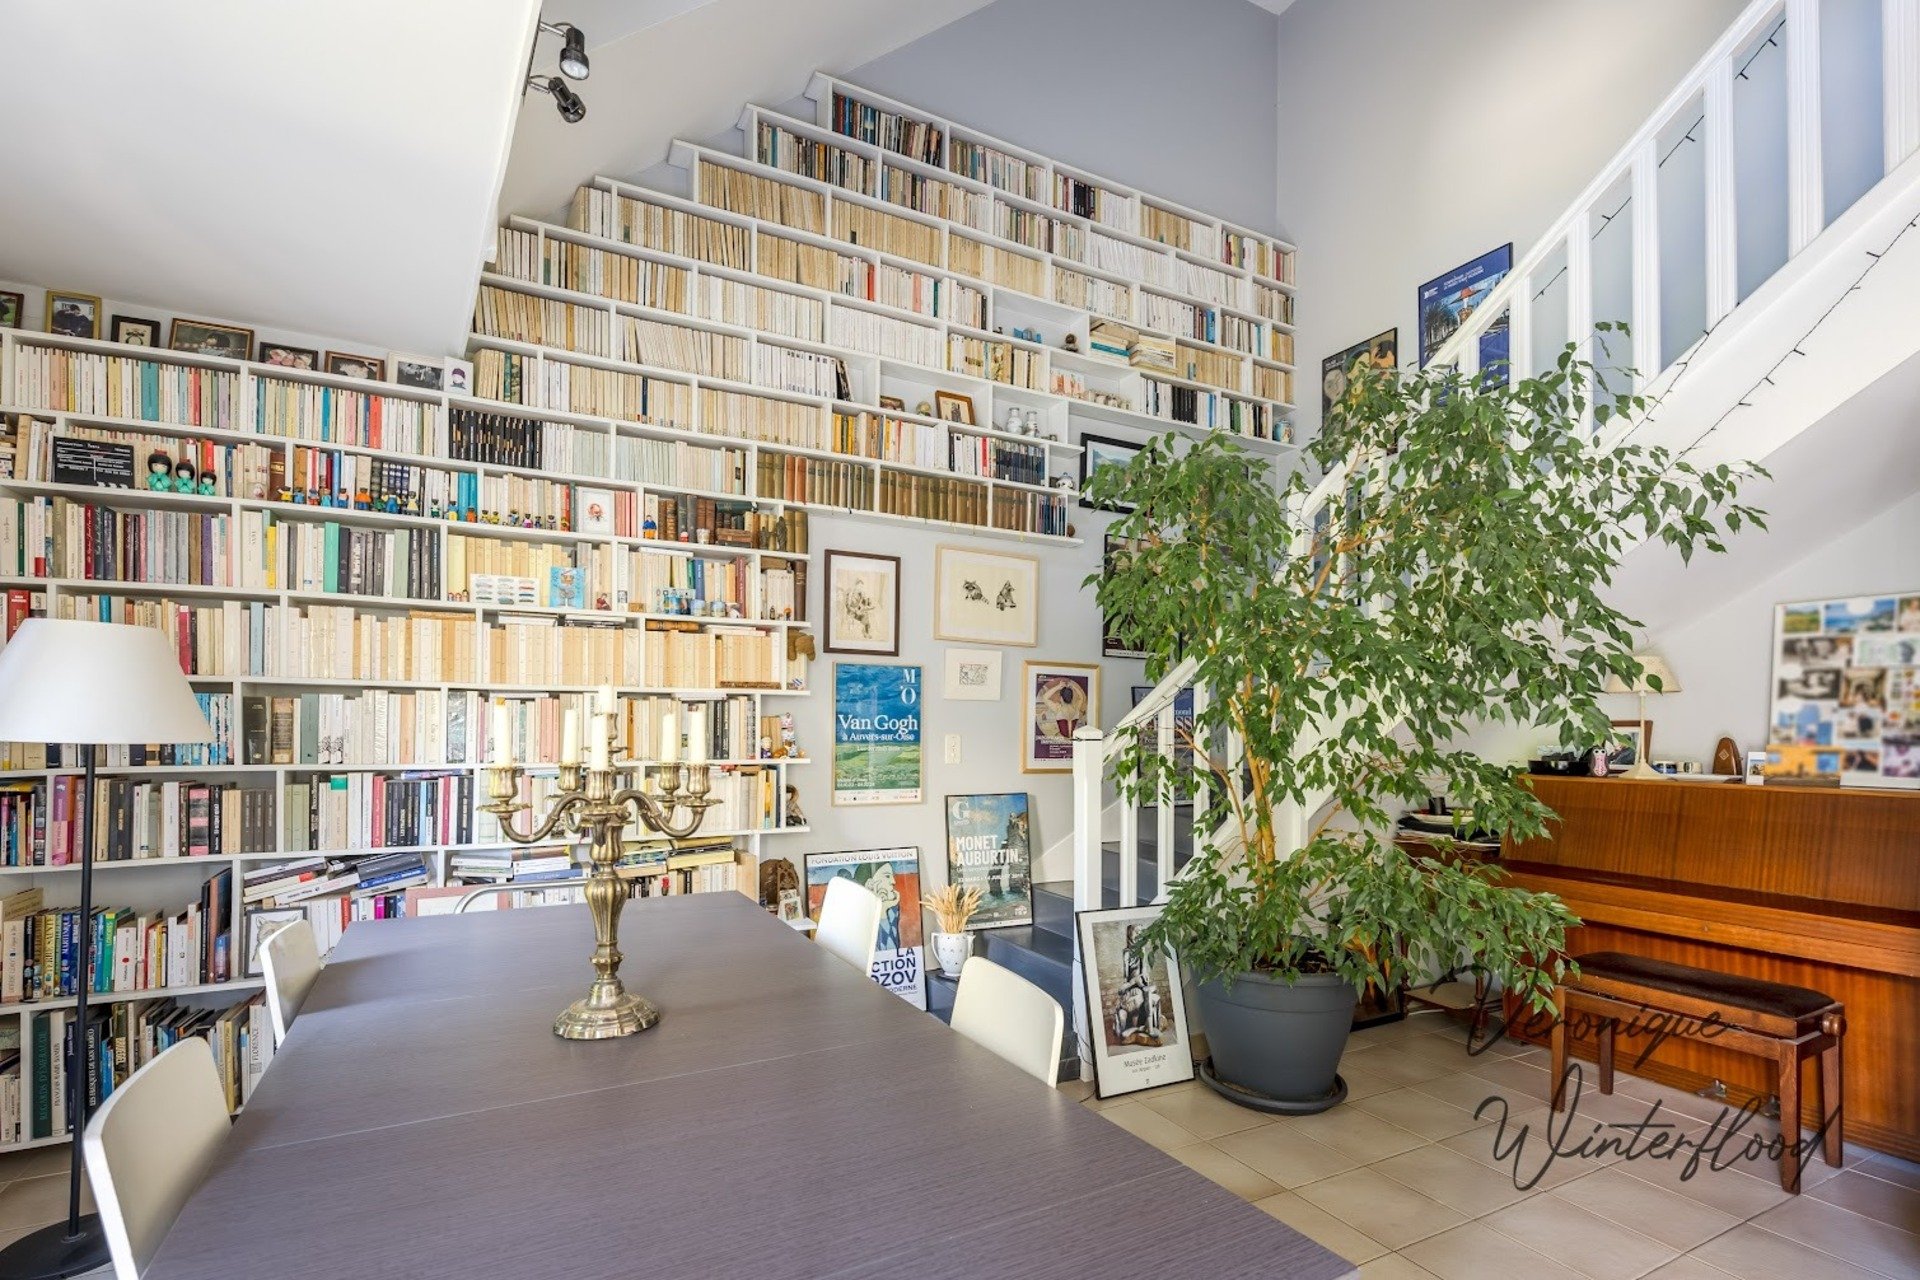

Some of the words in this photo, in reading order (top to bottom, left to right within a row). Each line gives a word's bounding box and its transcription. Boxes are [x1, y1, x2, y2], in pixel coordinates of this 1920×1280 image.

[903, 669, 916, 684] M
[838, 714, 871, 730] Van
[873, 714, 918, 735] Gogh
[842, 732, 848, 741] à
[850, 732, 915, 742] Auvers-sur-Oise
[956, 835, 998, 851] MONET
[811, 853, 858, 865] FONDATION
[858, 853, 881, 861] LOUIS
[881, 851, 914, 860] VUITTON
[61, 915, 71, 955] MARTINIQUE
[896, 947, 915, 958] LA
[251, 1028, 259, 1061] FLORENCE
